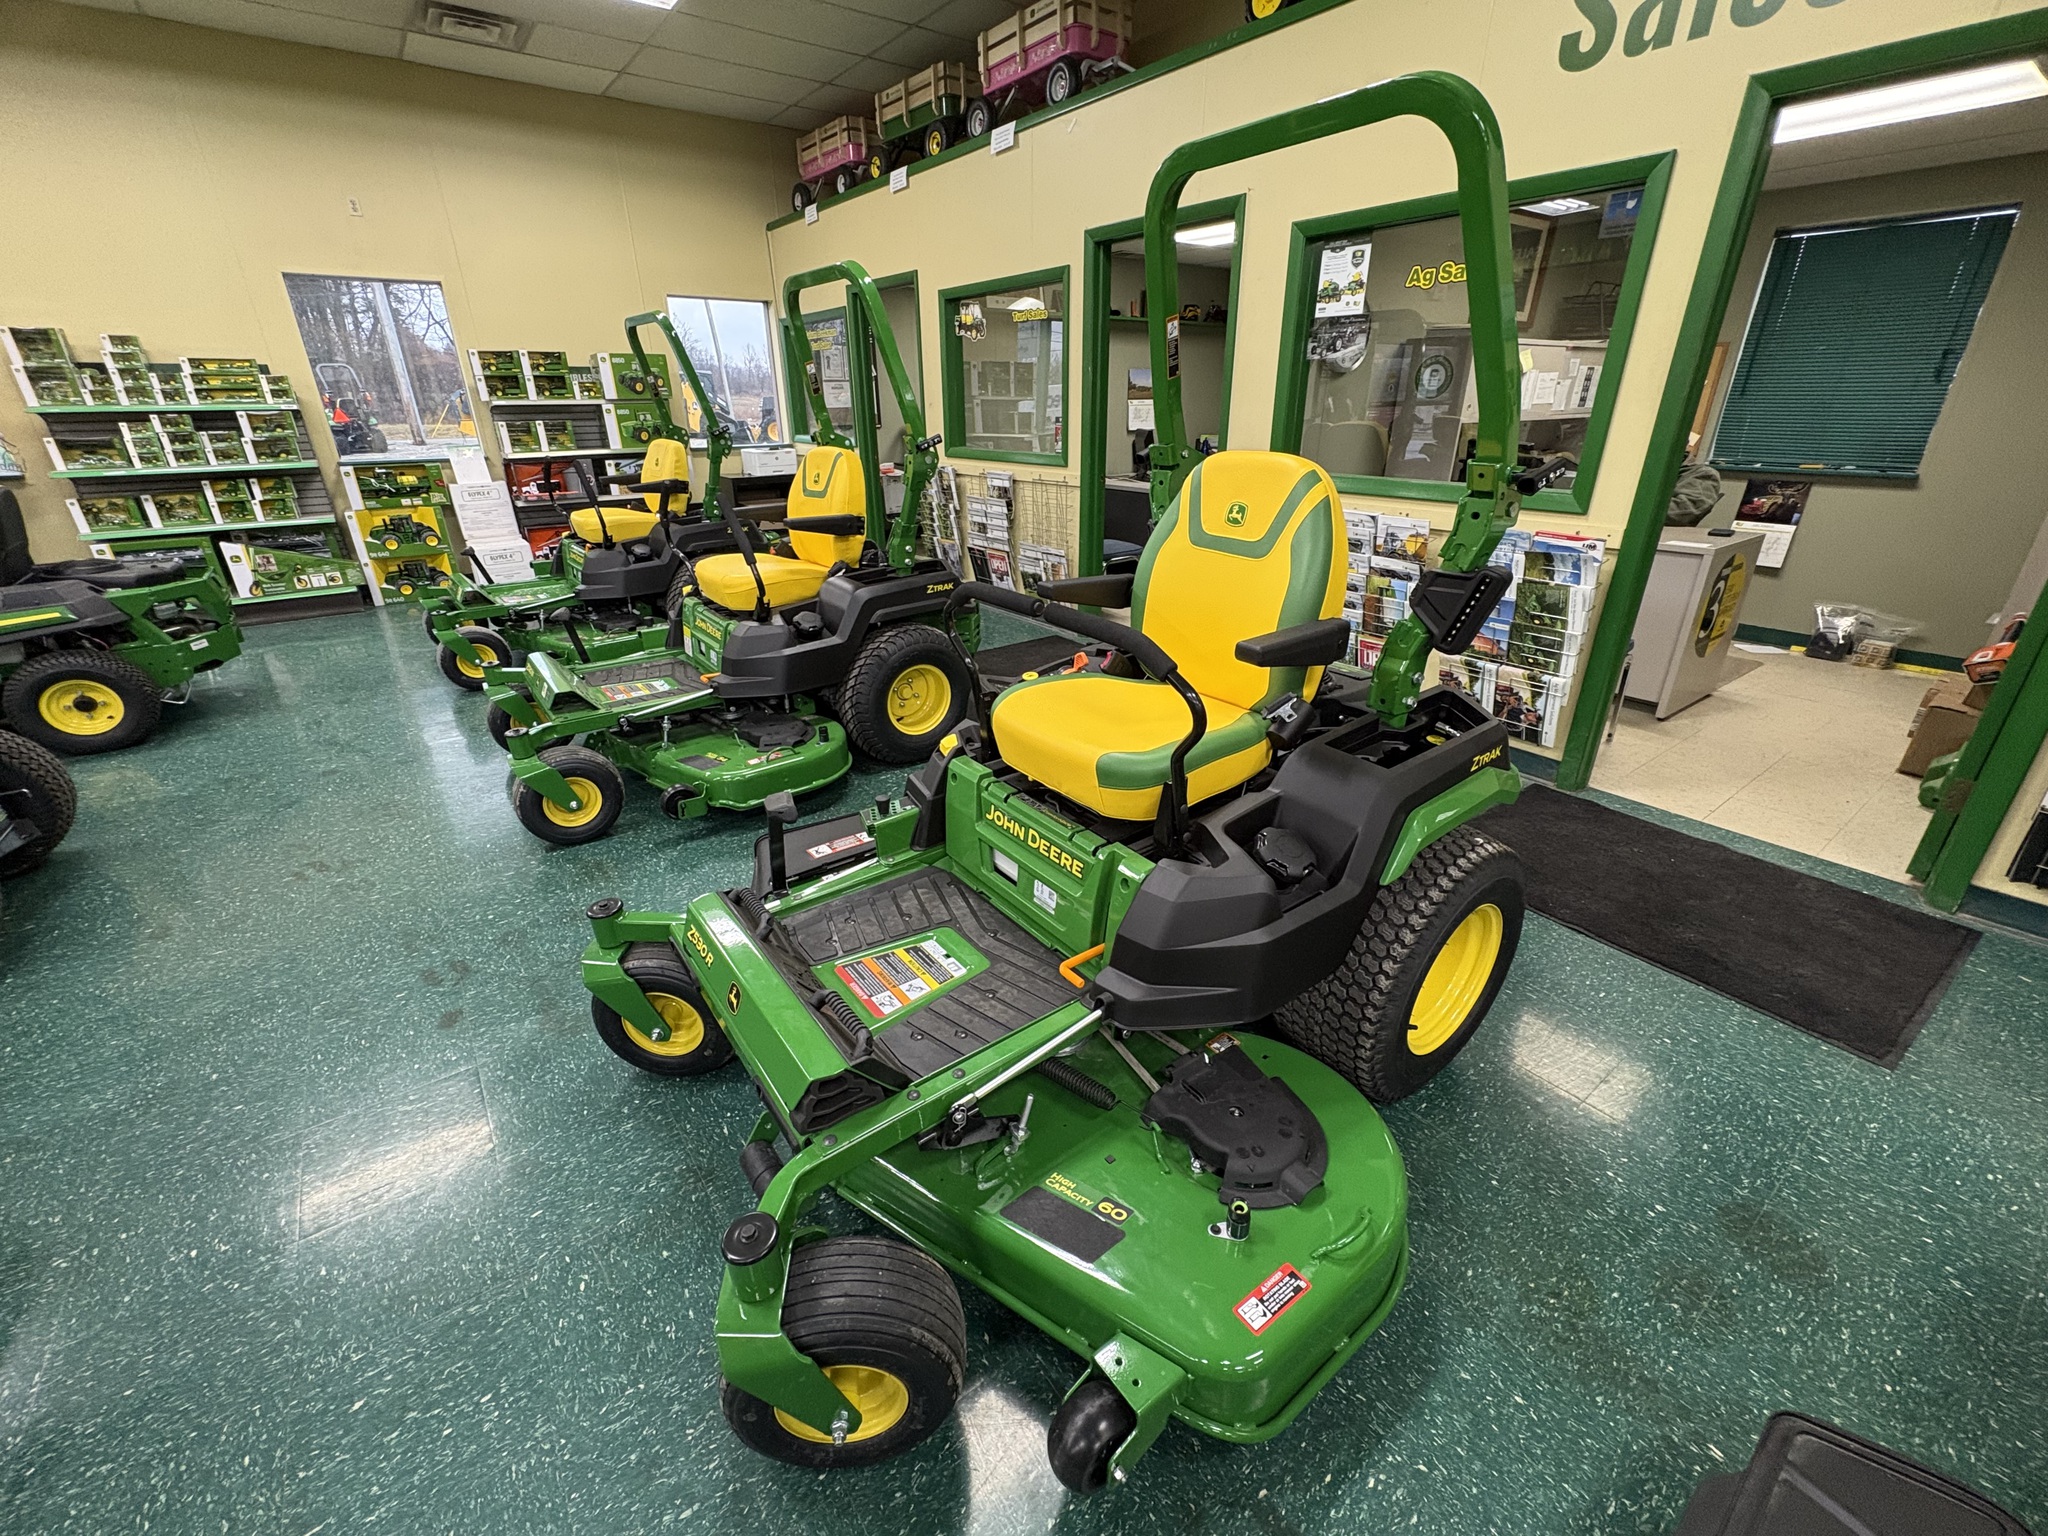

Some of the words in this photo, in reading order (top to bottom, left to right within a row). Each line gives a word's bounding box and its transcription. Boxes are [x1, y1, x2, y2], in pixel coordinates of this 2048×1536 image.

[1405, 266, 1436, 289] Ag
[1438, 260, 1467, 283] Sa
[1028, 309, 1048, 320] Sales
[927, 582, 954, 594] ZTRAK
[1470, 745, 1503, 772] ZTRAK
[986, 804, 1025, 841] JOHN
[1027, 828, 1084, 879] DEERE
[1050, 1172, 1077, 1189] HIGH
[1045, 1178, 1095, 1207] CAPACITY
[1097, 1201, 1128, 1221] 60
[1264, 1270, 1284, 1289] DANGER
